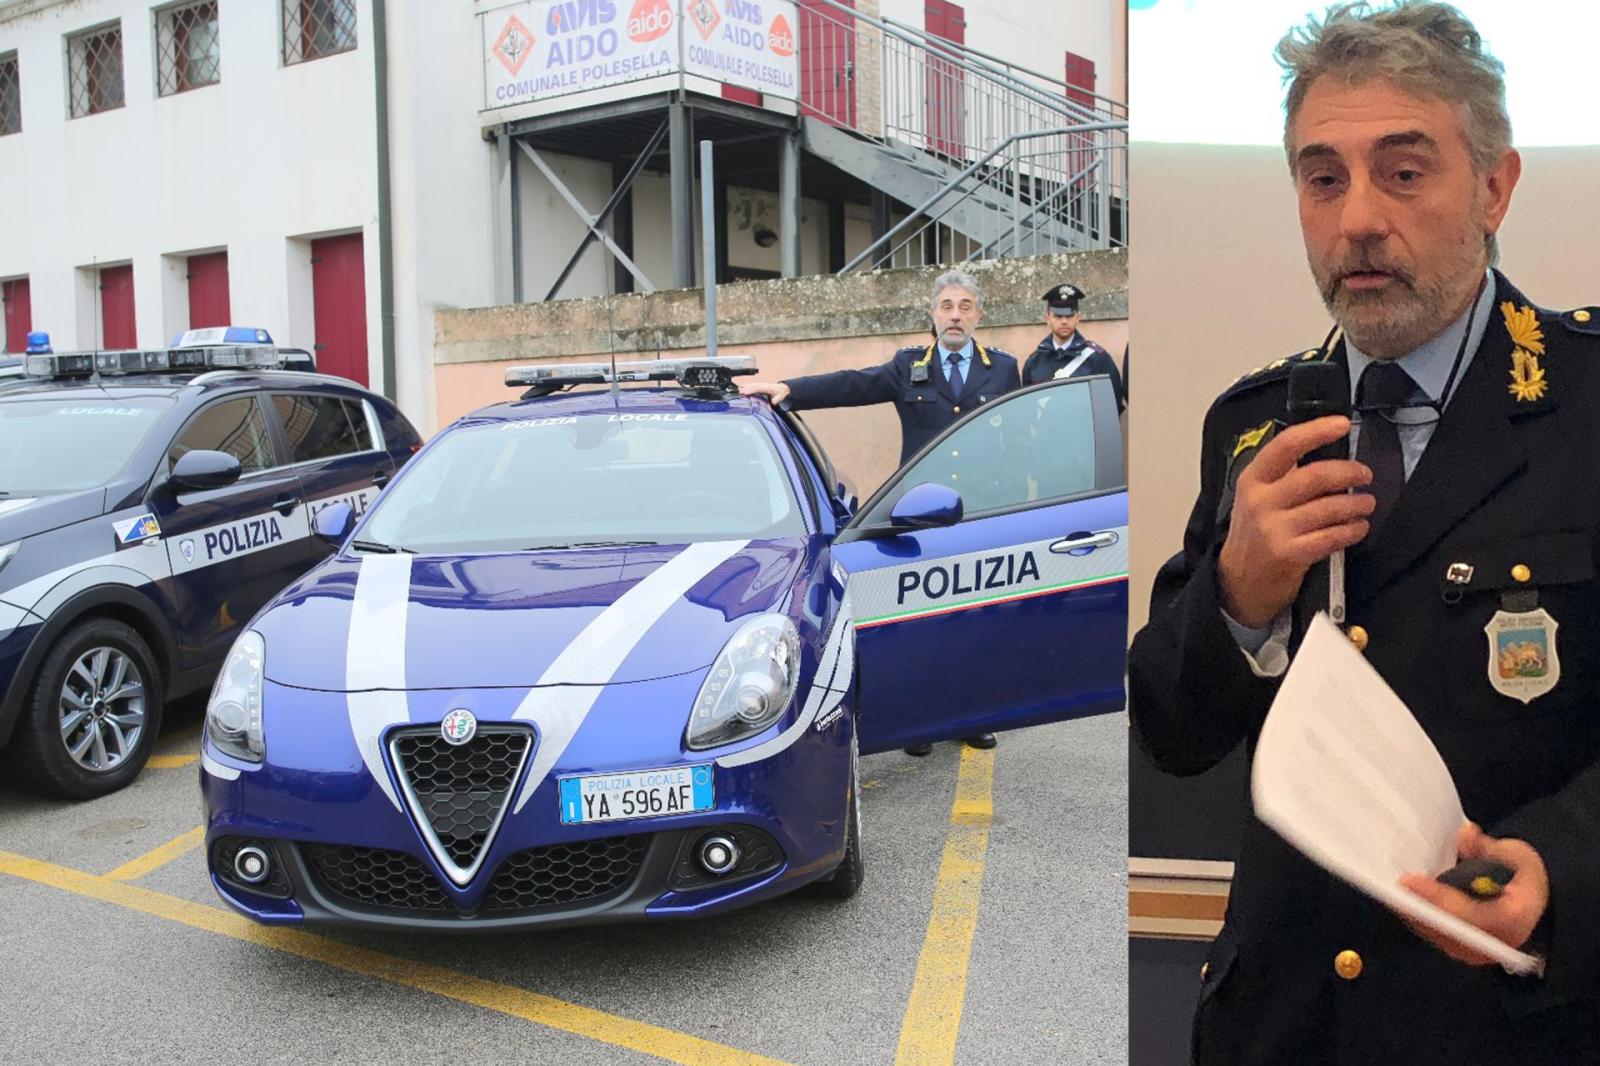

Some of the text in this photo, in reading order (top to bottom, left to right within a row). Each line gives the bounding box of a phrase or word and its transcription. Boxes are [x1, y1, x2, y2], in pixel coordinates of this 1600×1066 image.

[628, 4, 672, 36] aido
[722, 23, 765, 51] AIDO
[545, 28, 618, 69] AIDO
[496, 49, 671, 101] COMUNALE POLESELLA
[688, 45, 794, 89] COMUNALE POLESELLA
[58, 407, 145, 416] LOCALE
[501, 413, 688, 431] POLIZIA LOCALE
[204, 516, 283, 560] POLIZIA
[897, 550, 1041, 605] POLIZIA
[588, 773, 684, 792] POLIZIA LOCALE
[583, 785, 691, 819] YA 596 AF
